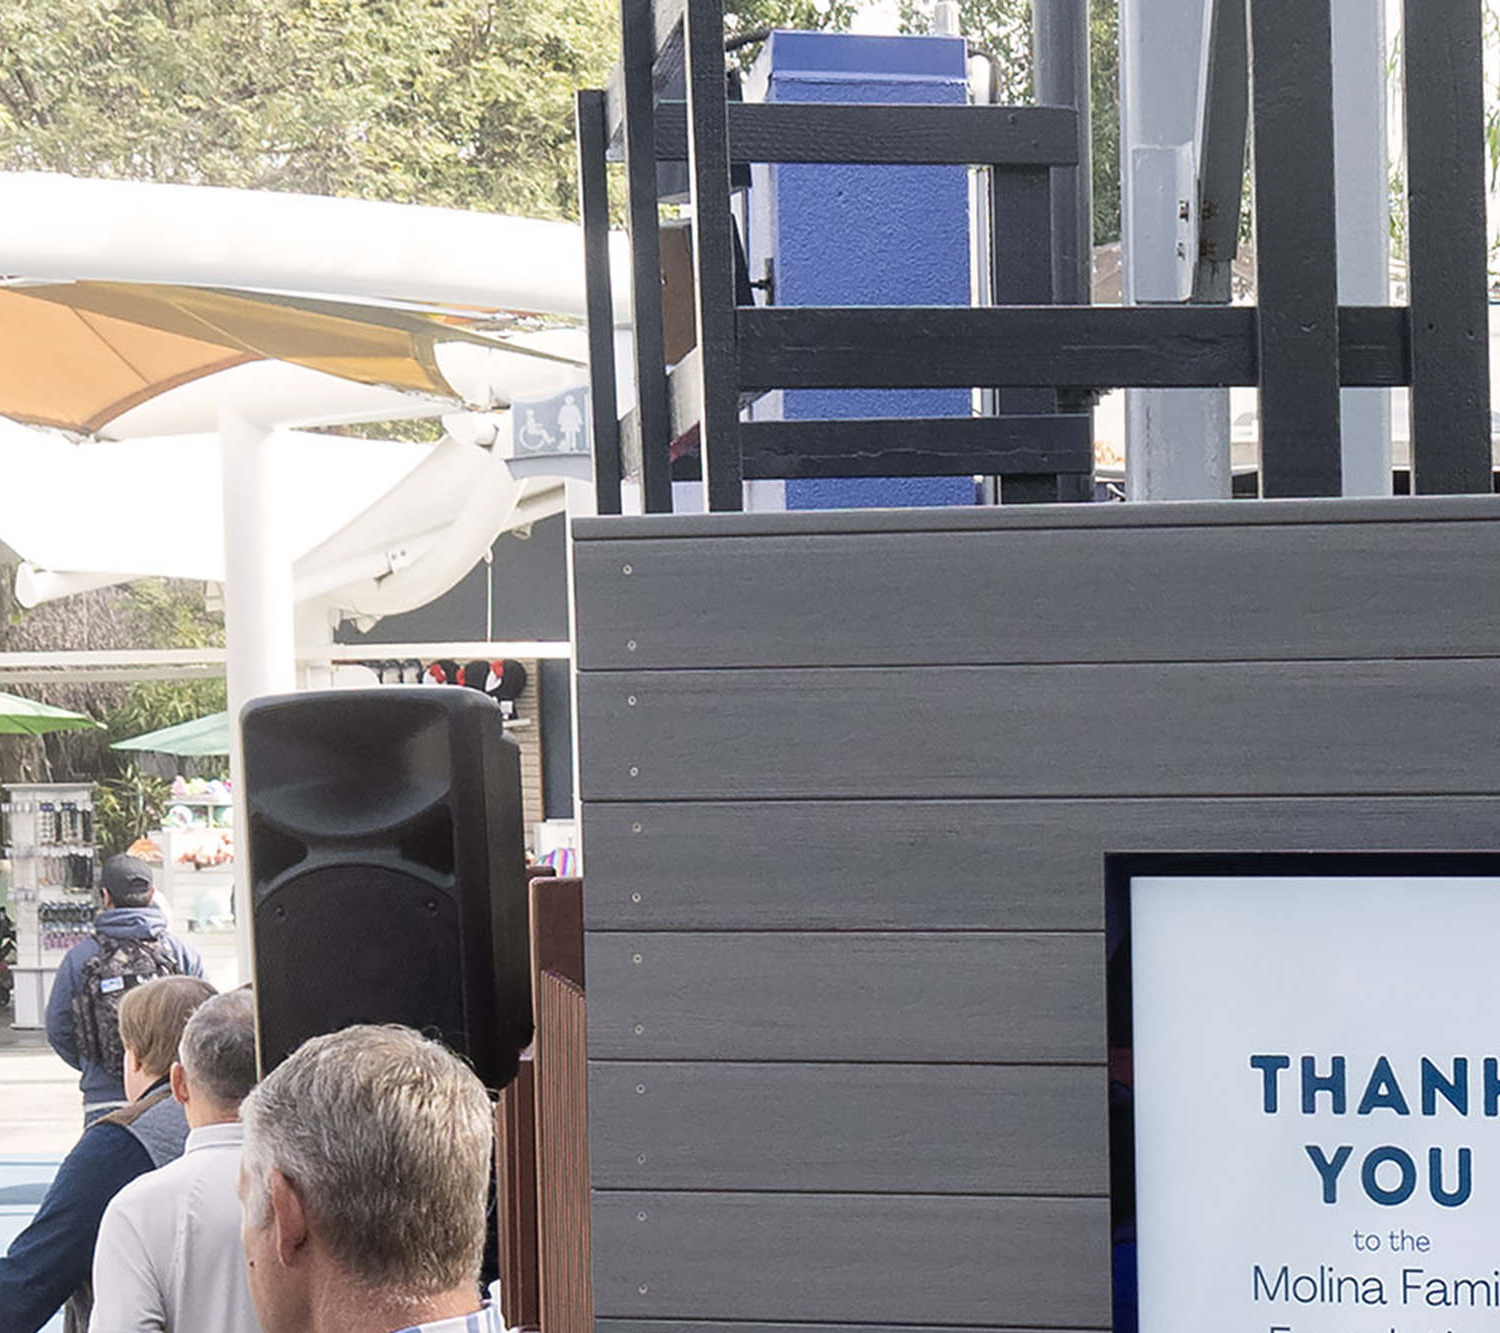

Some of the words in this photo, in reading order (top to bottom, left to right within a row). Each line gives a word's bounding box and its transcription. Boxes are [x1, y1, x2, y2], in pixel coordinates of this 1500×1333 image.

[1305, 1145, 1472, 1207] YOU
[1353, 1229, 1382, 1252] to
[1389, 1229, 1431, 1252] the
[1252, 1265, 1388, 1305] Molina
